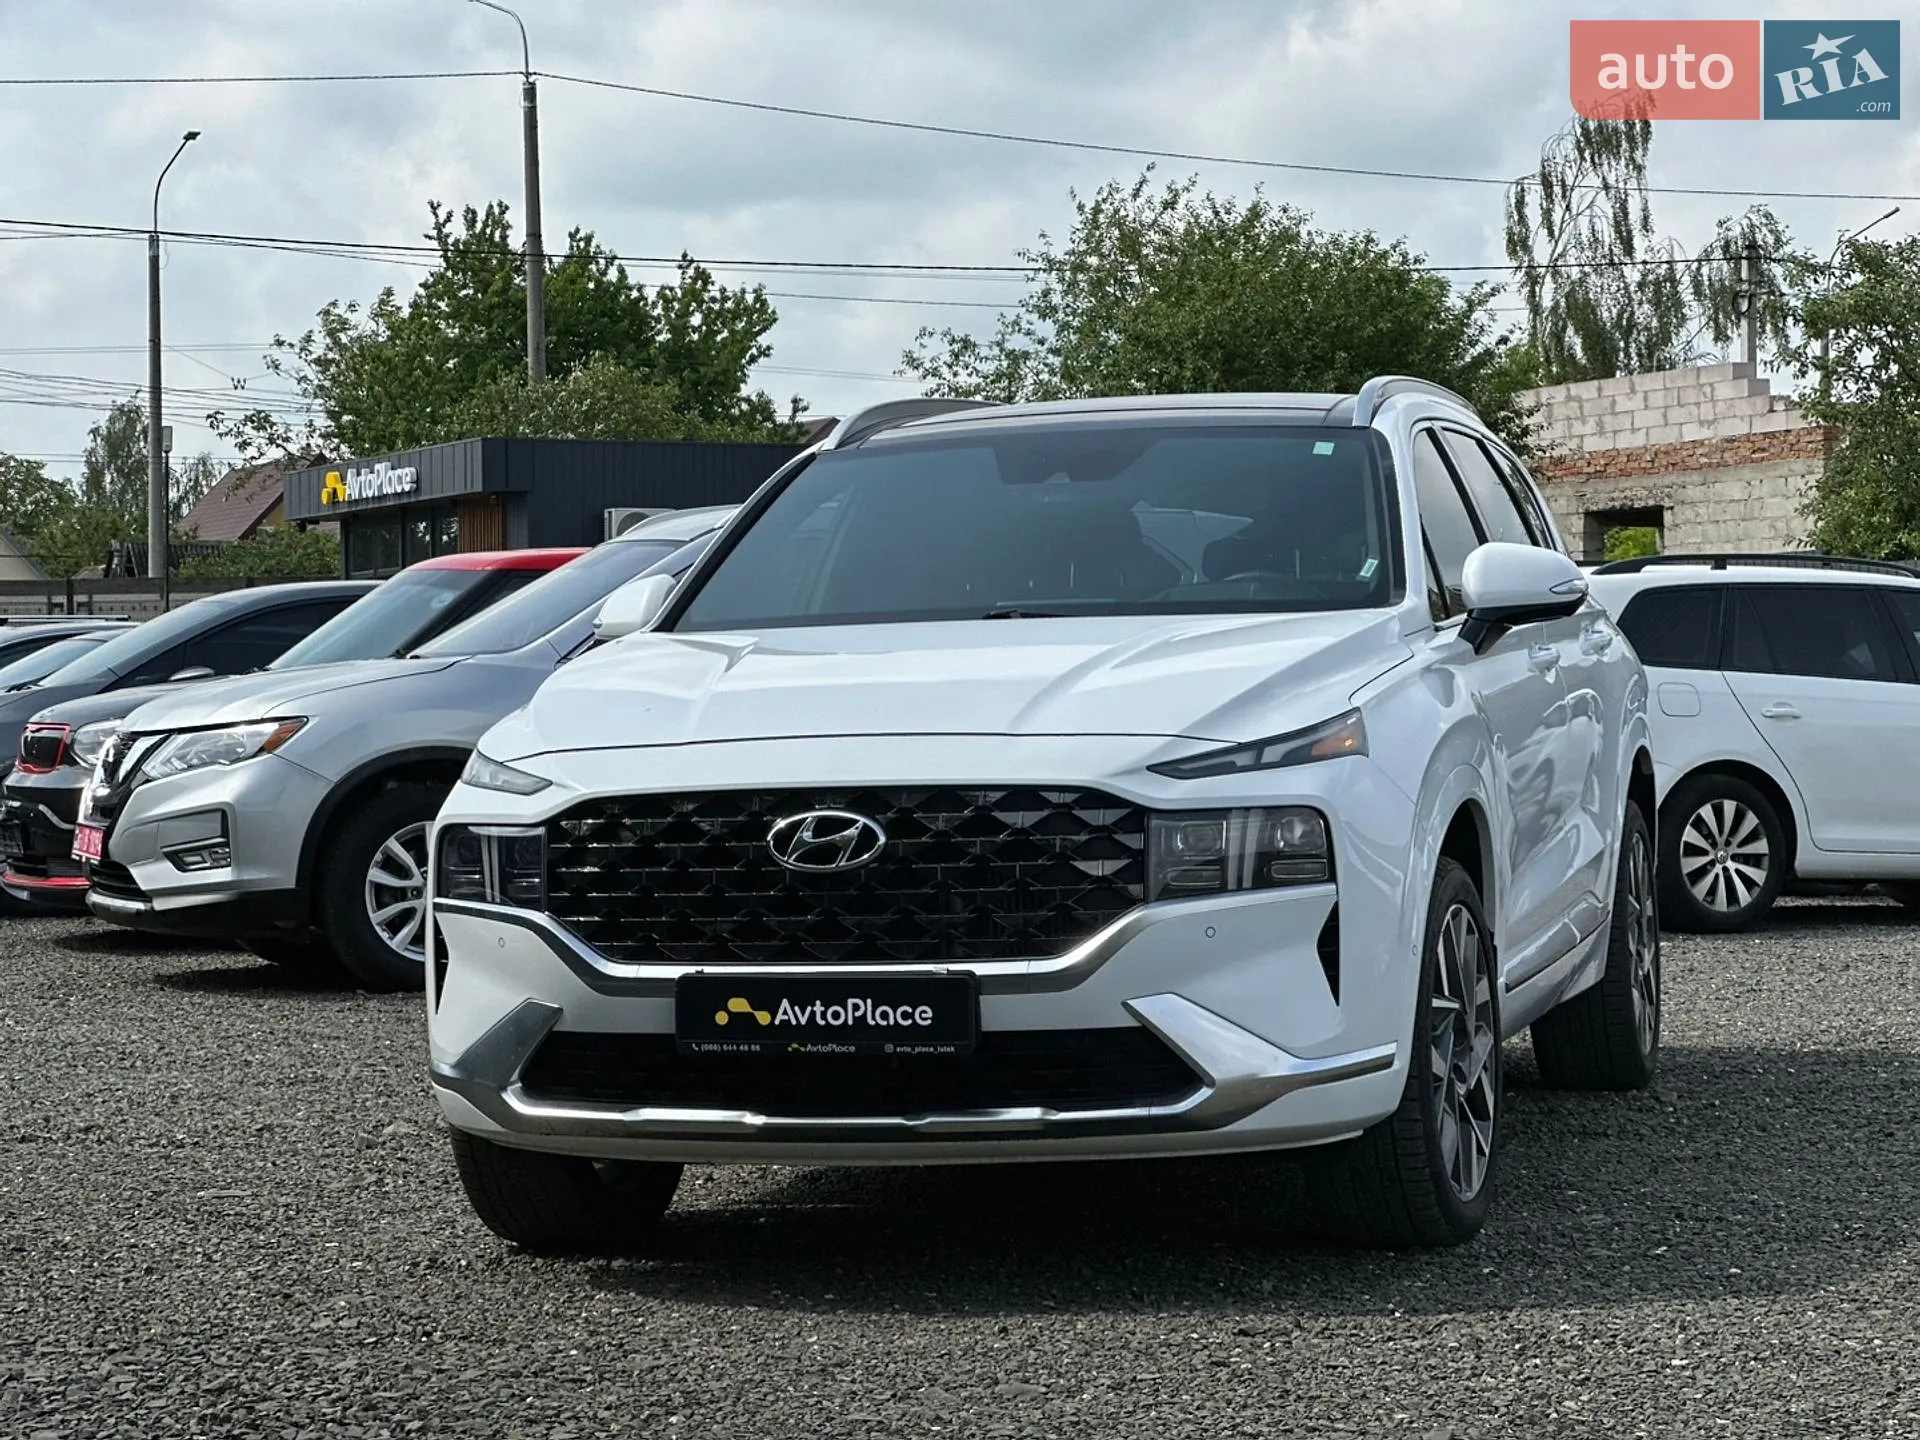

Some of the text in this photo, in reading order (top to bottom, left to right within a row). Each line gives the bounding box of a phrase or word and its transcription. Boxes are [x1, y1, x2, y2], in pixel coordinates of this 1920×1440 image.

[345, 461, 417, 500] AvtoPlace
[774, 998, 933, 1026] AvtoPlace
[806, 1043, 856, 1053] AvtoPlace
